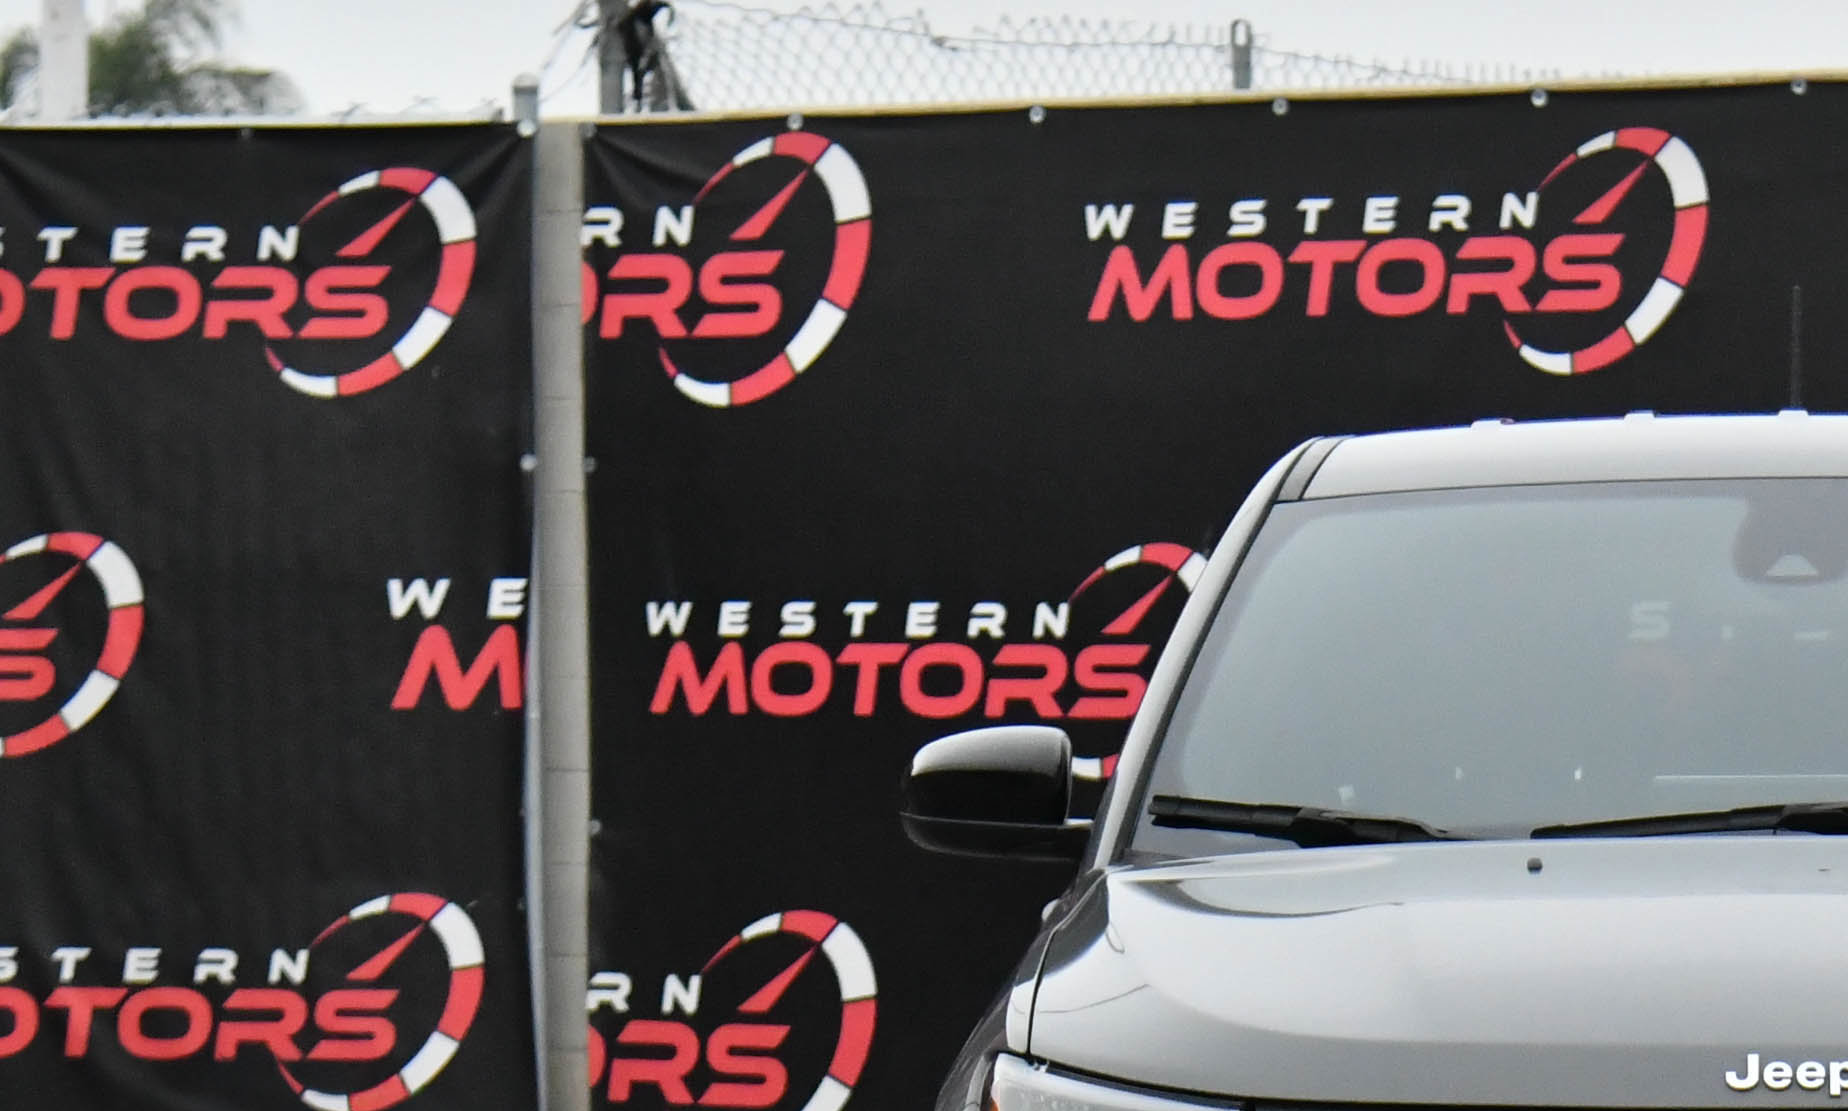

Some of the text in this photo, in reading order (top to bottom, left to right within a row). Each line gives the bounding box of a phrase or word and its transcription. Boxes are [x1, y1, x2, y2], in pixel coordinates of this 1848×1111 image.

[0, 226, 299, 263] TERN
[1084, 191, 1539, 241] WESTERN
[0, 265, 392, 341] TORS
[581, 250, 785, 340] RS
[1087, 233, 1625, 322] MOTORS
[645, 601, 1070, 639] WESTERN
[649, 640, 1151, 720] MOTORS
[587, 1018, 791, 1109] RS
